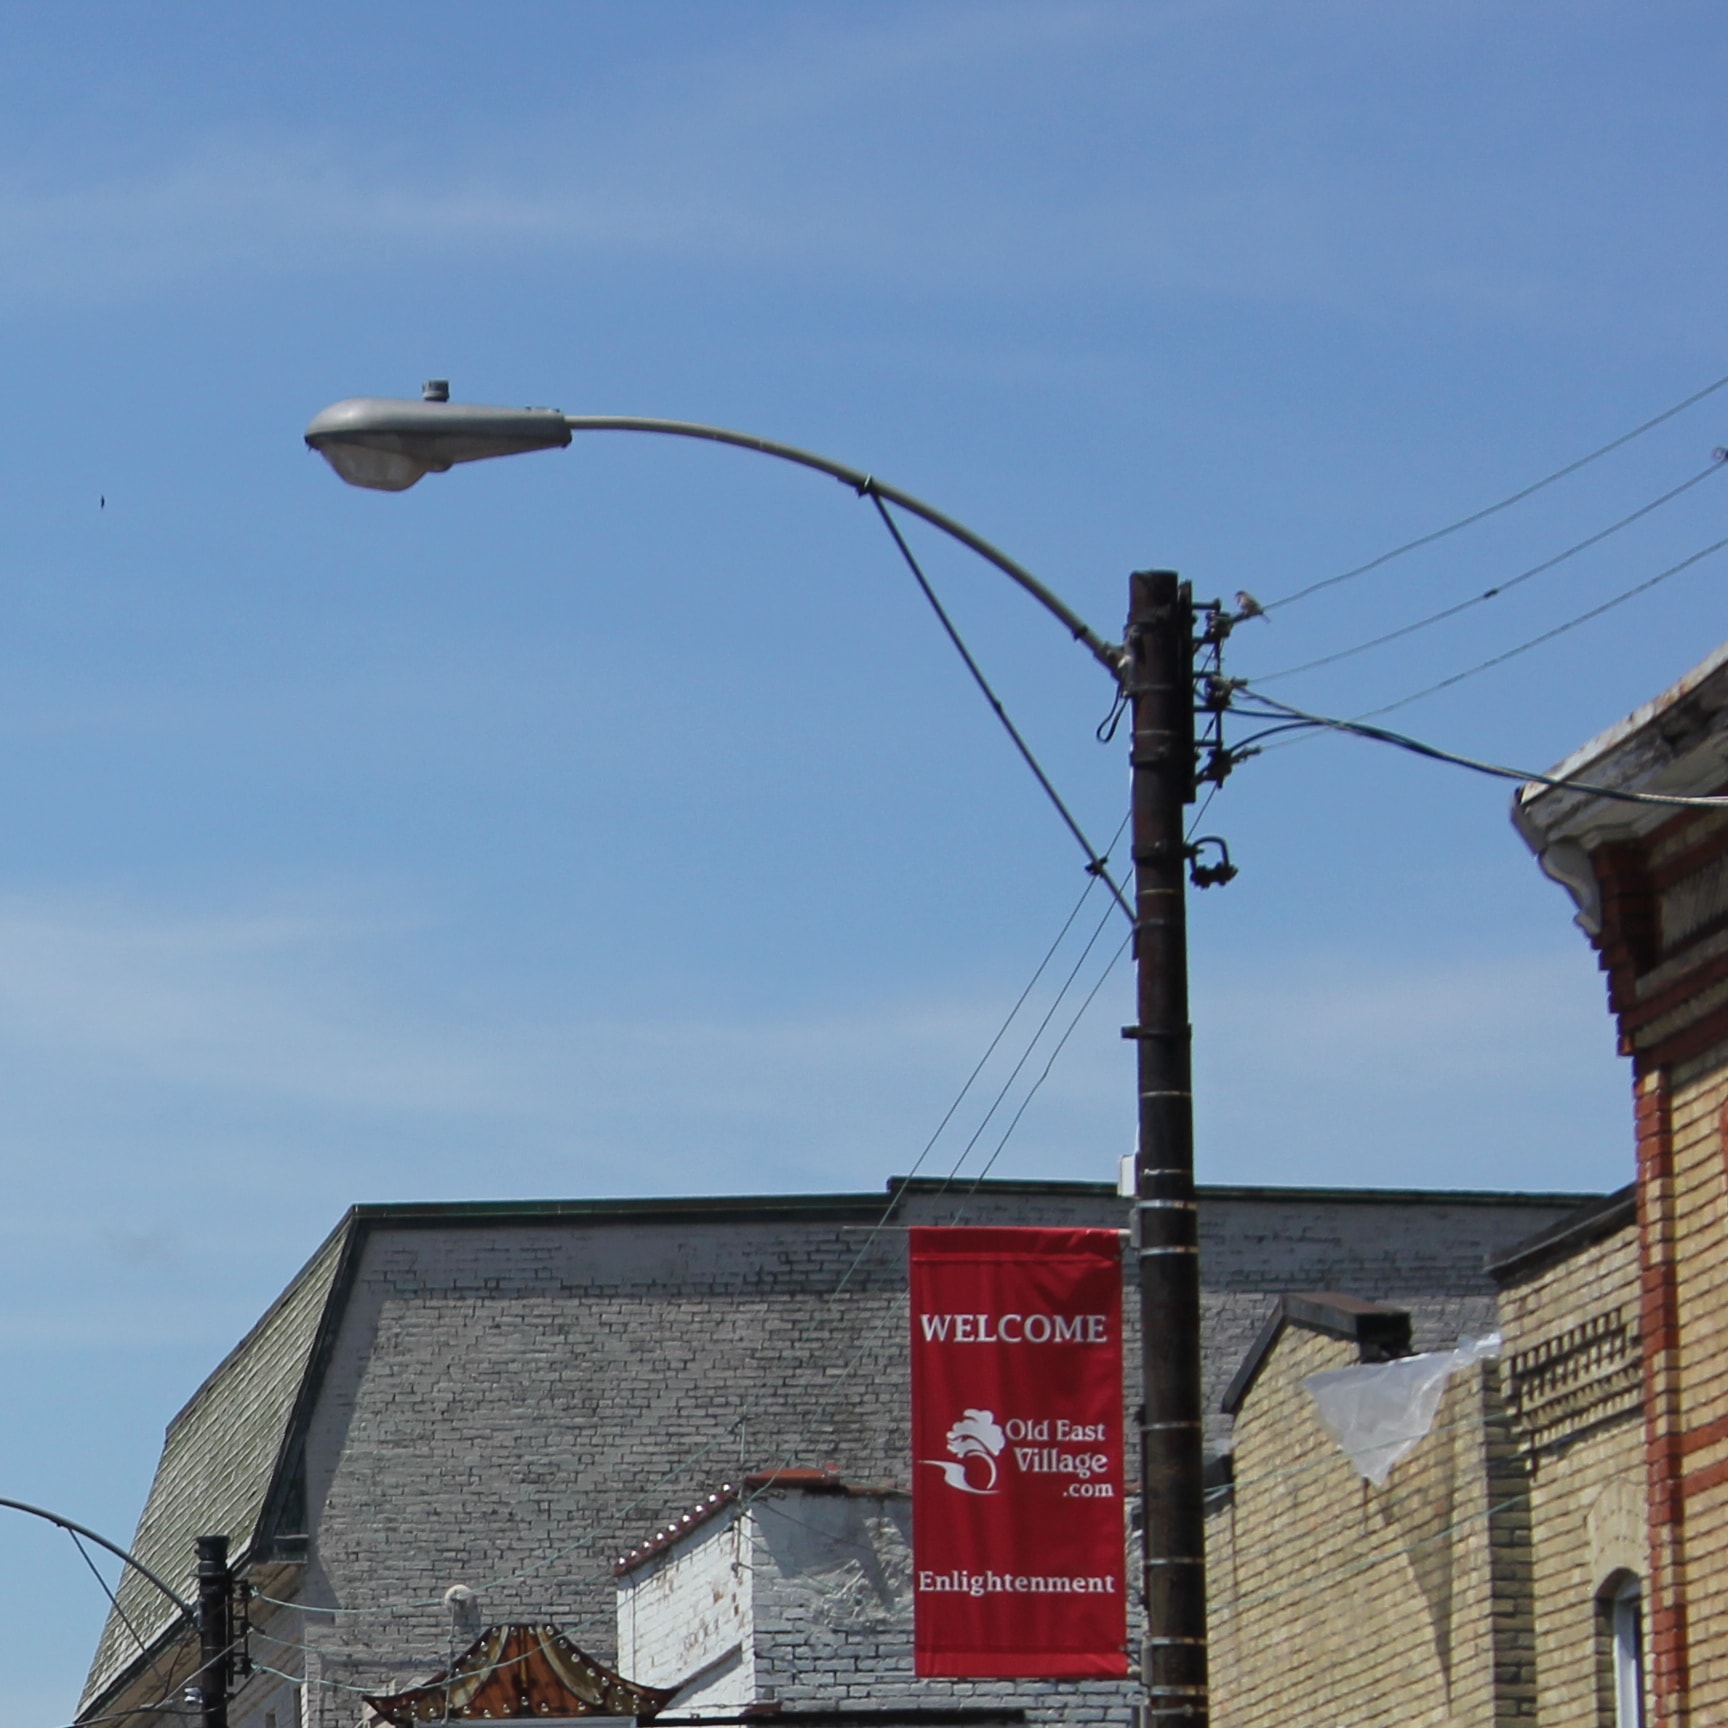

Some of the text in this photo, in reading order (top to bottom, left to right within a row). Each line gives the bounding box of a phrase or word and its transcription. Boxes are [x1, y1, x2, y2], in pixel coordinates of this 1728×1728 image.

[919, 1313, 1108, 1343] WELCOME
[1005, 1418, 1106, 1442] Old East
[1014, 1446, 1109, 1479] Village
[1062, 1481, 1115, 1498] .com
[918, 1570, 1115, 1597] Enlightenment
